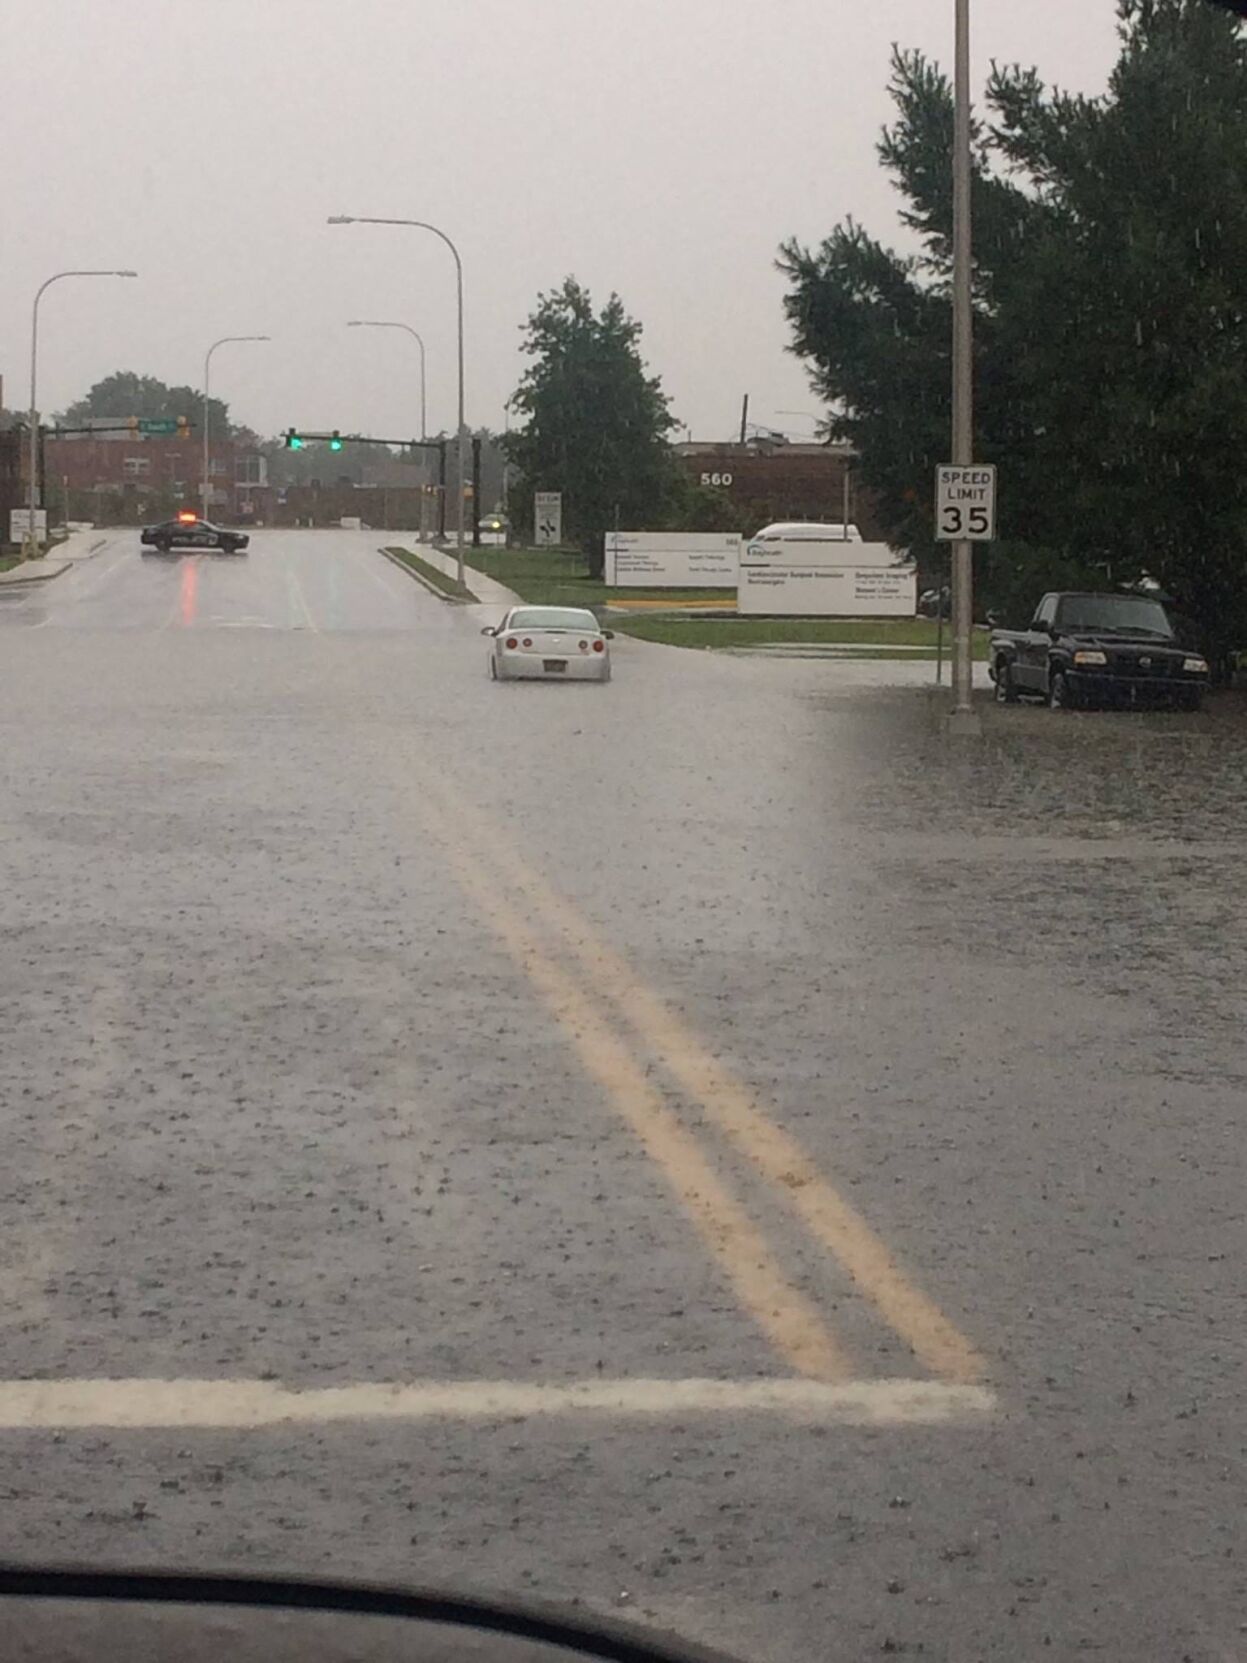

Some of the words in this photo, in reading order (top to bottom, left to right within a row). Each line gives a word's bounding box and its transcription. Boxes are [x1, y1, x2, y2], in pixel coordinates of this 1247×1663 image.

[701, 472, 733, 486] 560
[942, 472, 991, 484] SPEED
[947, 488, 985, 500] LIMIT
[942, 507, 989, 533] 35
